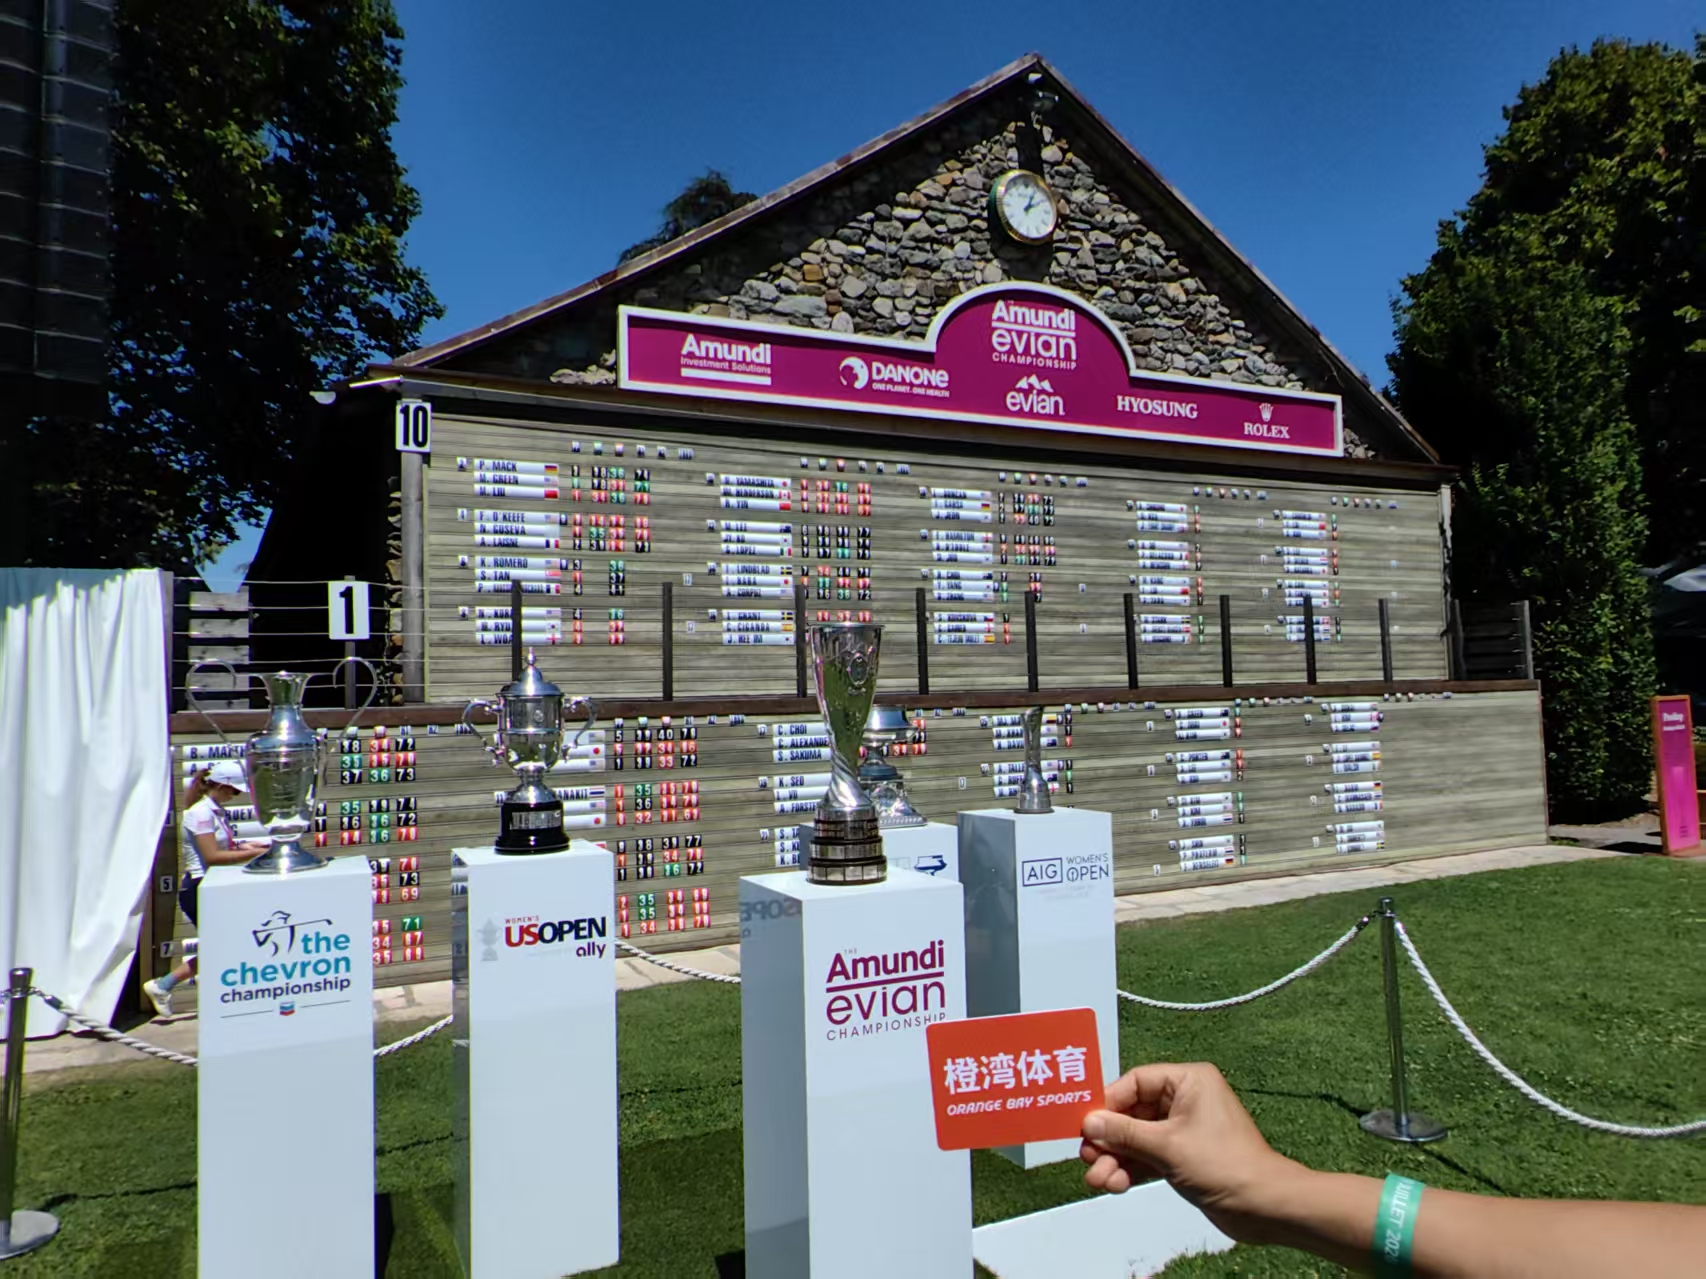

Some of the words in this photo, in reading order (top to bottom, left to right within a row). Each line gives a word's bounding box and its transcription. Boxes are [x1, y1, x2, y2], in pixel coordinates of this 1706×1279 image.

[992, 299, 1075, 330] Amundi
[681, 333, 771, 364] Amundi
[992, 329, 1077, 360] evian
[681, 356, 729, 370] Investment
[731, 362, 771, 374] Solutions
[992, 352, 1077, 370] CHAMPIONSHIP
[1006, 389, 1065, 416] evian
[1117, 395, 1198, 419] HYOSUNG
[400, 405, 428, 448] 10
[1244, 422, 1290, 439] ROLEX
[492, 461, 517, 472] MACK
[492, 474, 519, 485] GREEN
[492, 487, 505, 497] LIU
[492, 511, 525, 523] O'KEEFE
[492, 525, 526, 535] GUSEVA
[493, 558, 528, 568] ROMERO
[494, 571, 510, 581] TAN
[610, 572, 624, 583] 37
[339, 585, 354, 634] 1
[616, 731, 622, 742] 5
[659, 729, 673, 740] 40
[778, 725, 787, 735] C.
[790, 724, 807, 735] CHOI
[659, 756, 673, 767] 33
[778, 751, 787, 761] S.
[790, 750, 821, 761] SAKUMA
[343, 770, 360, 783] 37
[371, 769, 388, 781] 36
[398, 768, 413, 780] 73
[779, 777, 788, 787] K.
[791, 776, 804, 786] SEO
[636, 784, 651, 796] 35
[343, 802, 359, 814] 35
[637, 799, 651, 810] 36
[779, 804, 789, 813] A.
[399, 813, 414, 825] 72
[637, 812, 651, 824] 32
[780, 829, 789, 839] S.
[687, 836, 700, 847] 77
[780, 842, 789, 852] S.
[664, 852, 678, 864] 34
[780, 855, 789, 865] K.
[1027, 863, 1057, 881] AIG
[1066, 853, 1108, 865] WOMEN'S
[1066, 864, 1109, 882] OPEN
[163, 878, 170, 890] 5
[402, 873, 416, 884] 73
[402, 887, 417, 899] 69
[639, 894, 654, 906] 35
[505, 915, 539, 924] WOMEN'S
[640, 908, 655, 920] 35
[404, 917, 419, 930] 71
[641, 922, 655, 934] 34
[301, 931, 350, 954] the
[576, 941, 606, 959] ally
[373, 951, 391, 964] 35
[826, 939, 944, 983] Amundi
[221, 956, 351, 987] chevron
[220, 977, 351, 1003] championship
[826, 981, 945, 1025] evian
[827, 1012, 946, 1041] CHAMPIONSHIP
[944, 1044, 1087, 1095] 橙湾体育
[947, 1099, 1003, 1116] ORANGE
[1006, 1096, 1034, 1110] BAY
[1036, 1090, 1092, 1107] SPORTS
